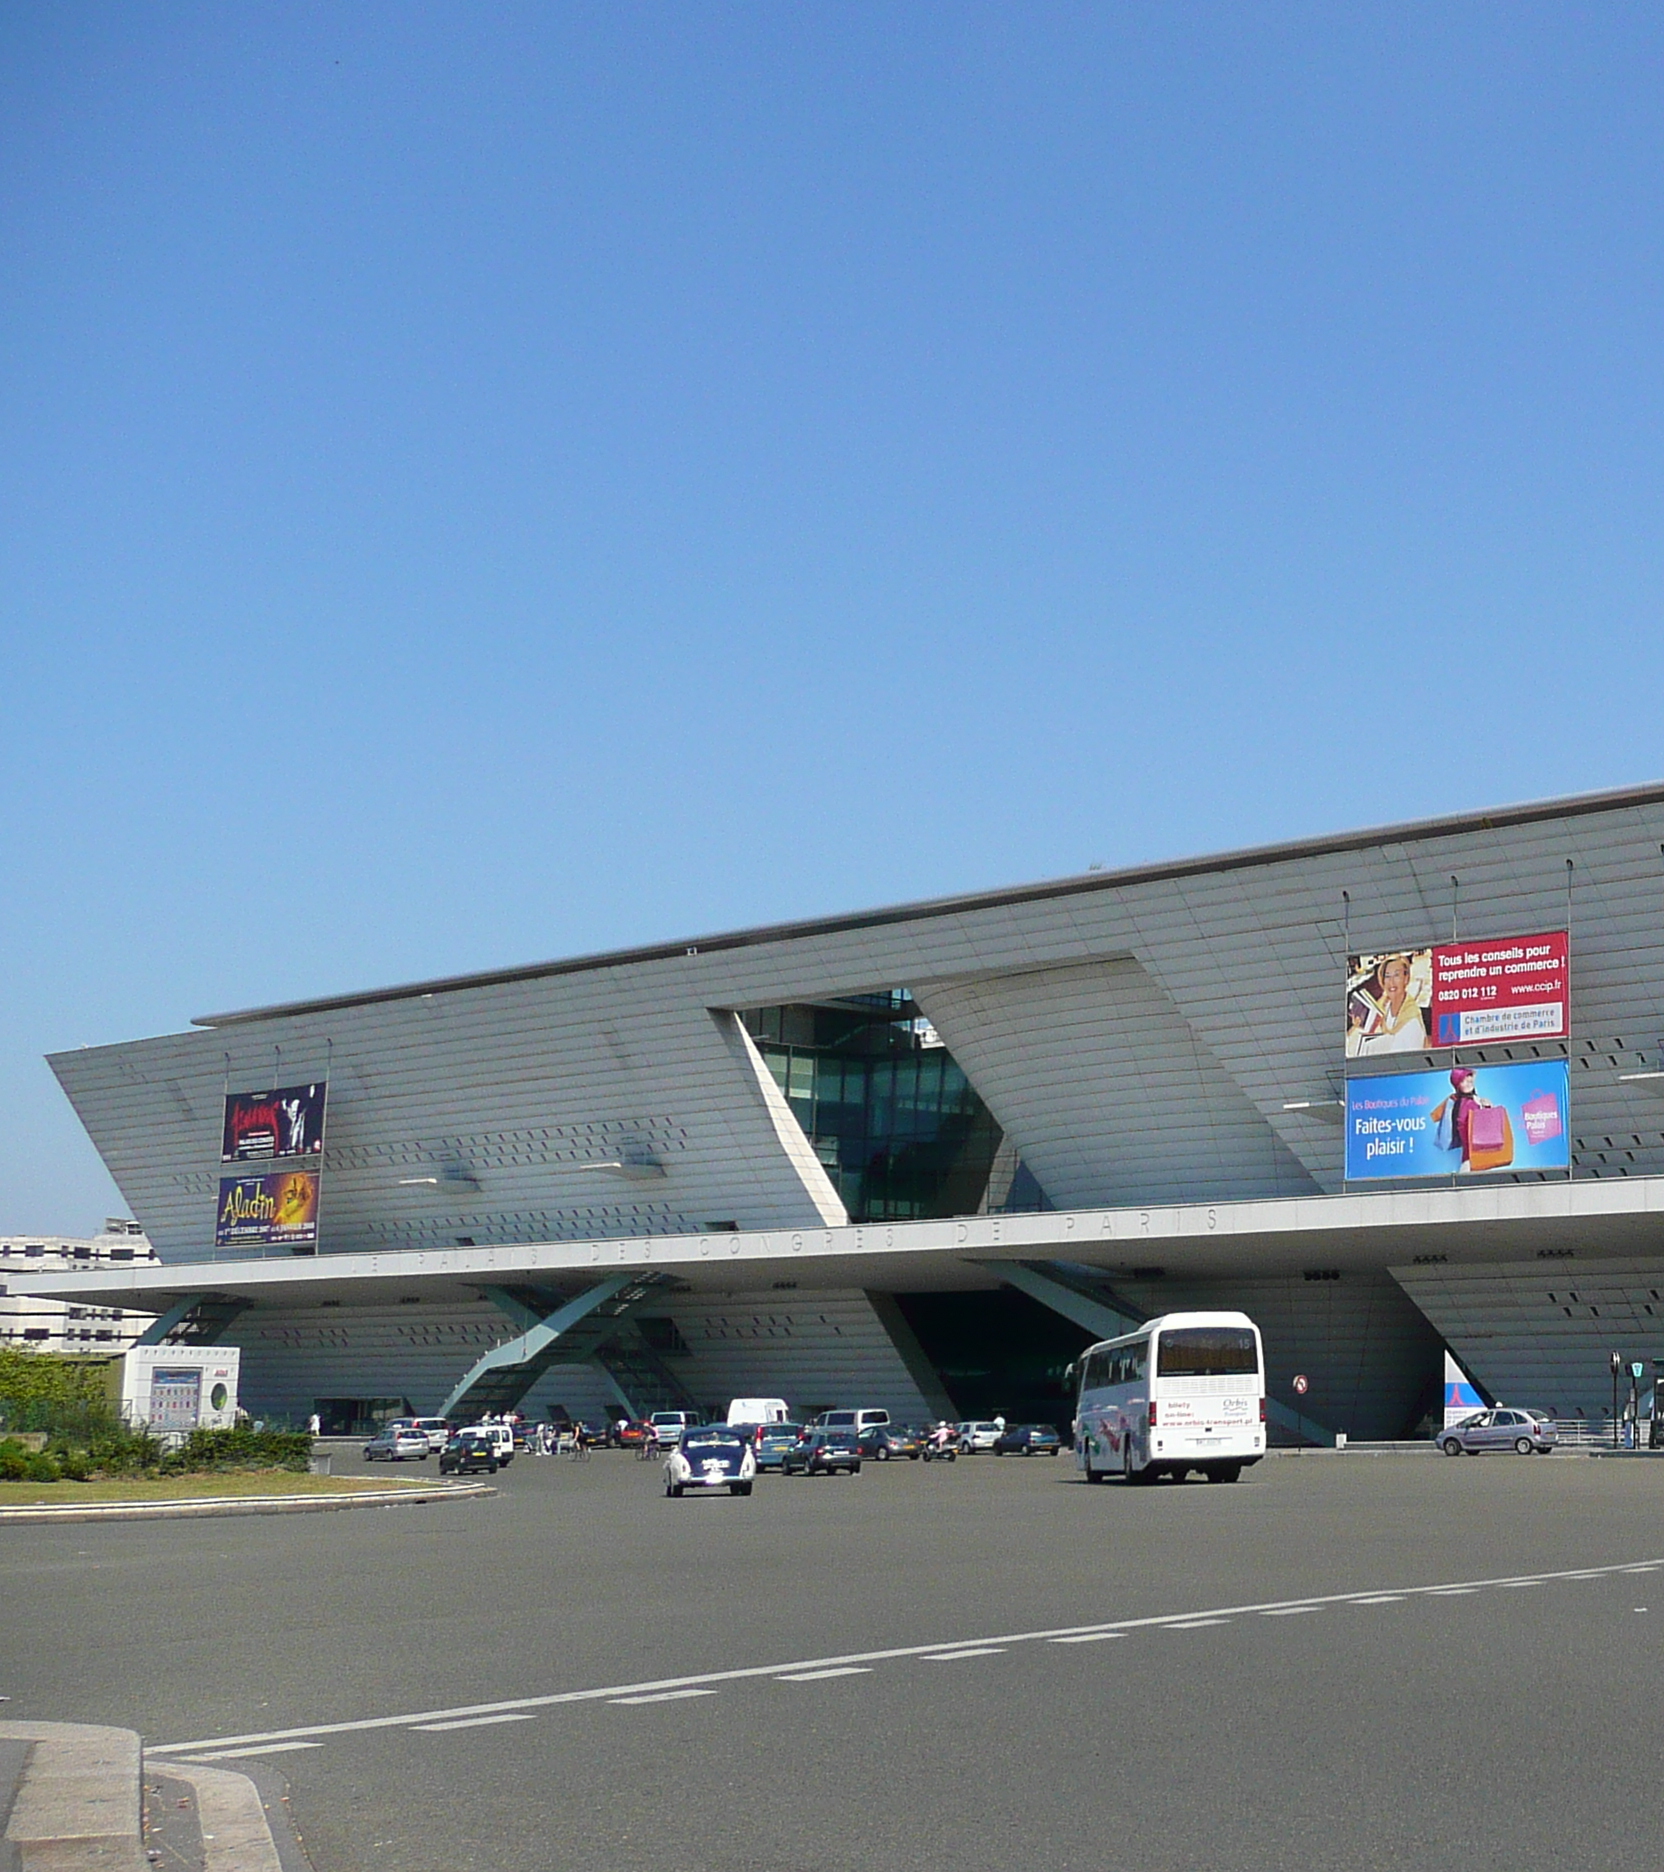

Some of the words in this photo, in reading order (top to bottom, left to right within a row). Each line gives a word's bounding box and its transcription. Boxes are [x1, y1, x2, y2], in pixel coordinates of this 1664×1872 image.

[1438, 955, 1462, 967] Tous
[1465, 952, 1479, 964] les
[1482, 947, 1523, 961] conseils
[1526, 945, 1550, 959] pour
[1438, 966, 1487, 982] reprendre
[1489, 965, 1502, 975] un
[1505, 959, 1559, 973] commerce
[1462, 987, 1478, 998] 012
[1481, 985, 1497, 997] 112
[1511, 979, 1561, 994] www.ccip.fr
[1465, 1013, 1499, 1024] Chambre
[1501, 1011, 1511, 1020] de
[1513, 1009, 1554, 1019] commerce
[1465, 1026, 1473, 1035] et
[1475, 1022, 1518, 1034] d'industrie
[1521, 1020, 1531, 1029] de
[1533, 1018, 1555, 1028] Paris
[1352, 1101, 1363, 1111] Les
[1364, 1098, 1398, 1110] Boutiques
[1355, 1116, 1426, 1135] Faites-vous
[1366, 1136, 1406, 1160] plaisir
[1409, 1136, 1414, 1153] !
[221, 1182, 276, 1226] Aladin
[591, 1241, 651, 1261] DES
[956, 1221, 1001, 1243] DE
[1065, 1208, 1217, 1239] PARIS
[1223, 1398, 1248, 1407] Orbis
